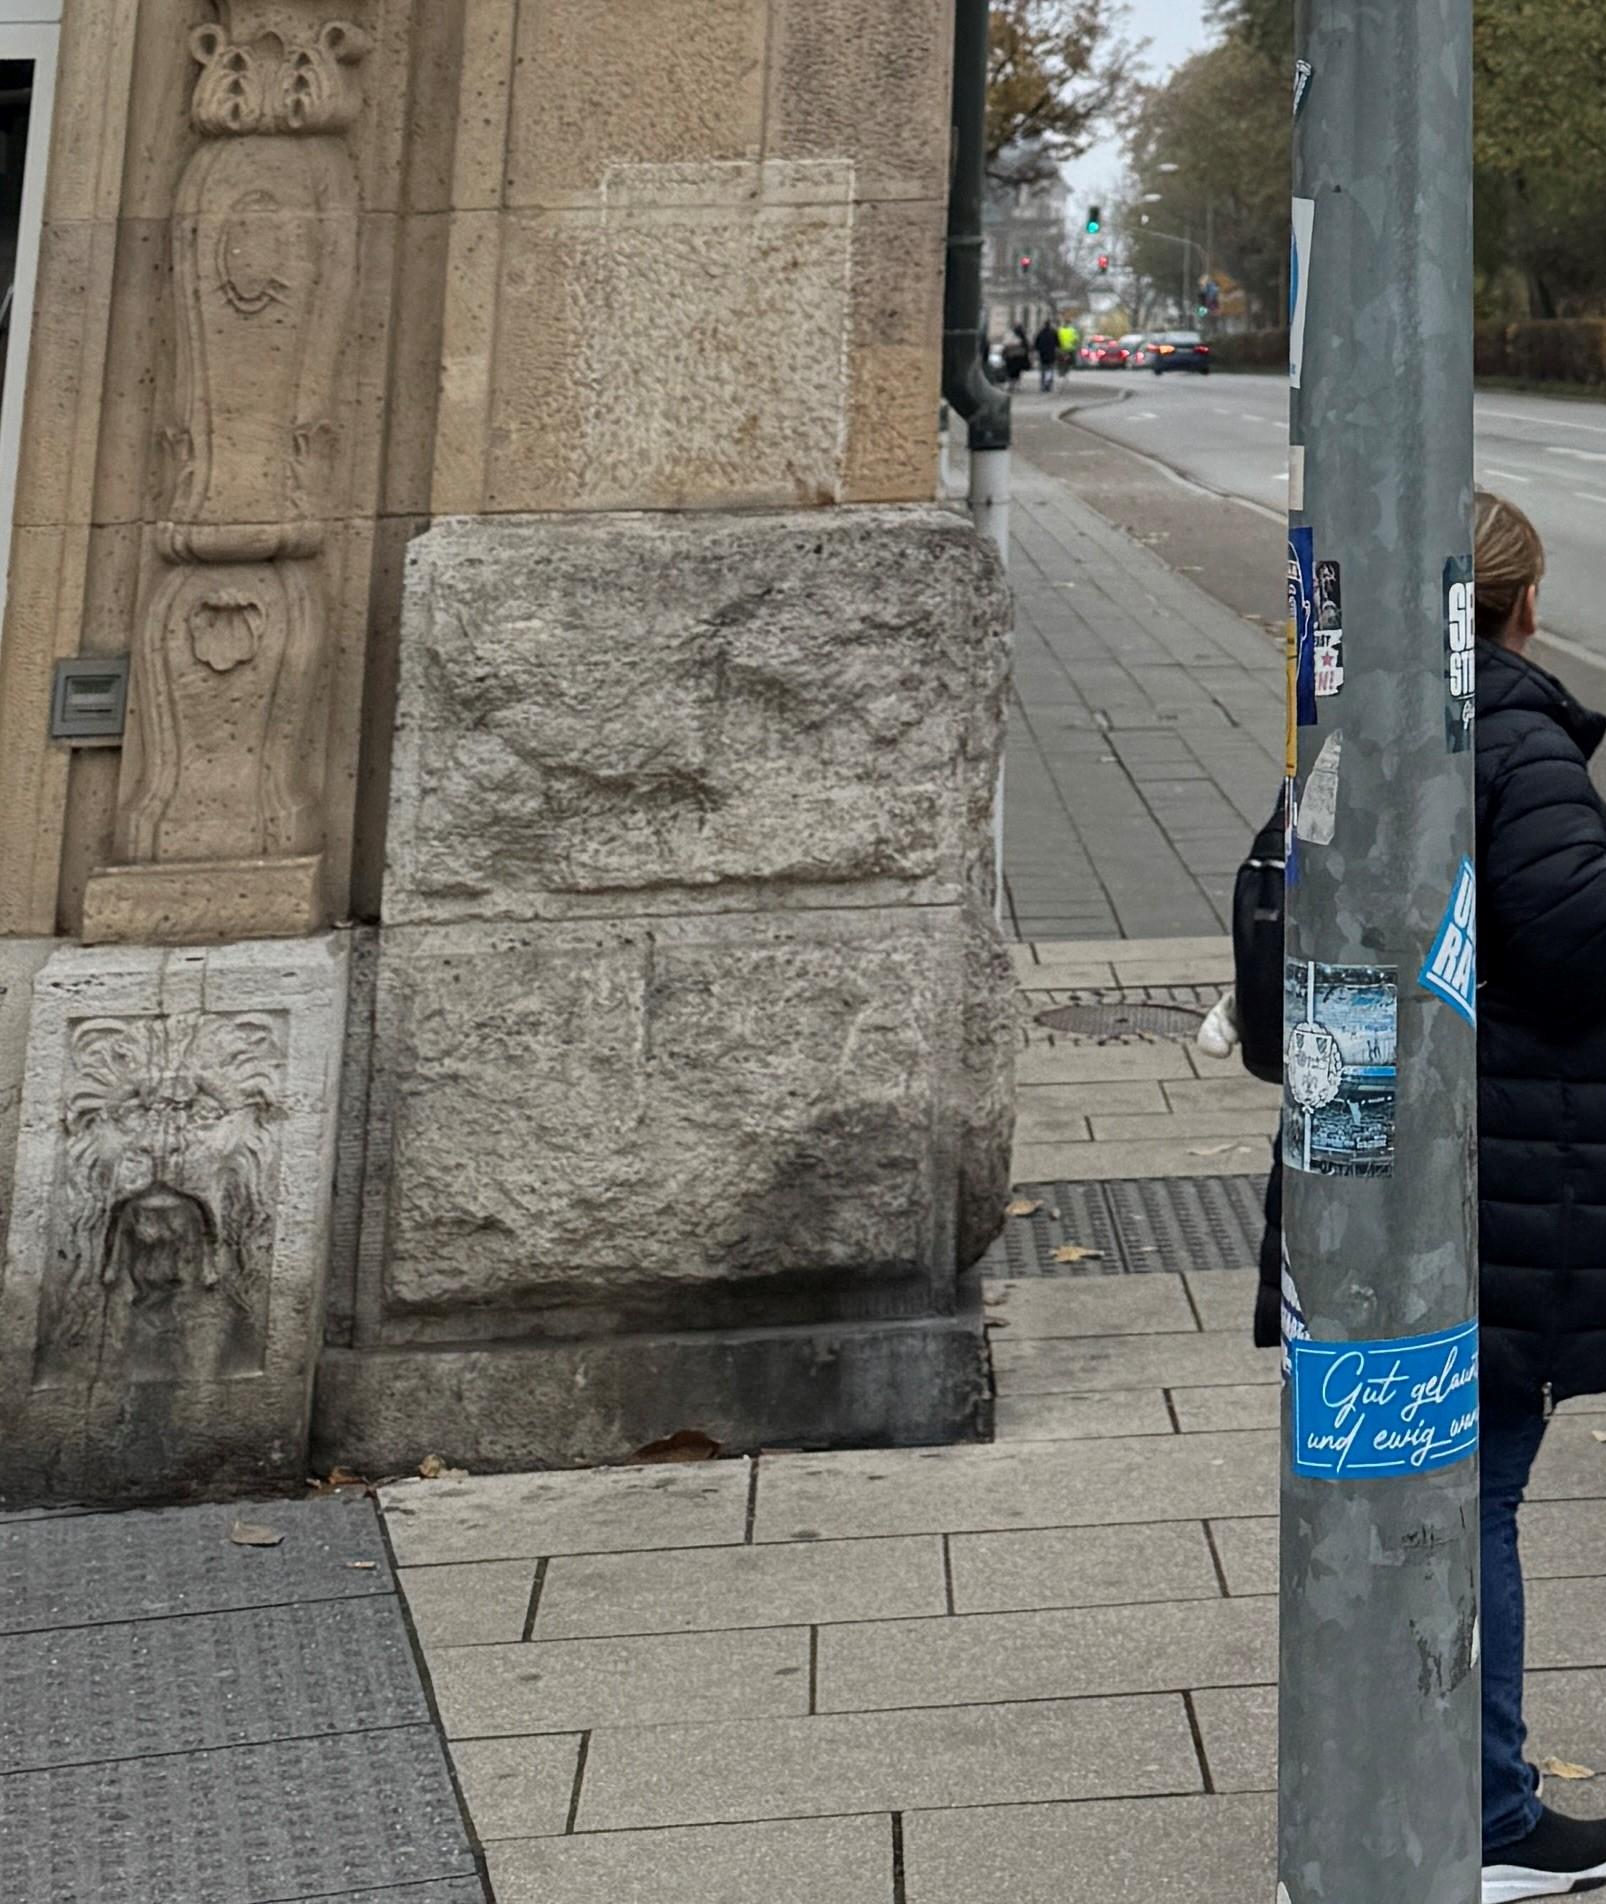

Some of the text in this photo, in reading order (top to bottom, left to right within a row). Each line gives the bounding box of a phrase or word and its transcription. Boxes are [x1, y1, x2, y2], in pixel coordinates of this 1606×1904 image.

[1322, 1351, 1410, 1429] Gut
[1307, 1412, 1366, 1474] und
[1373, 1418, 1453, 1467] ewig
